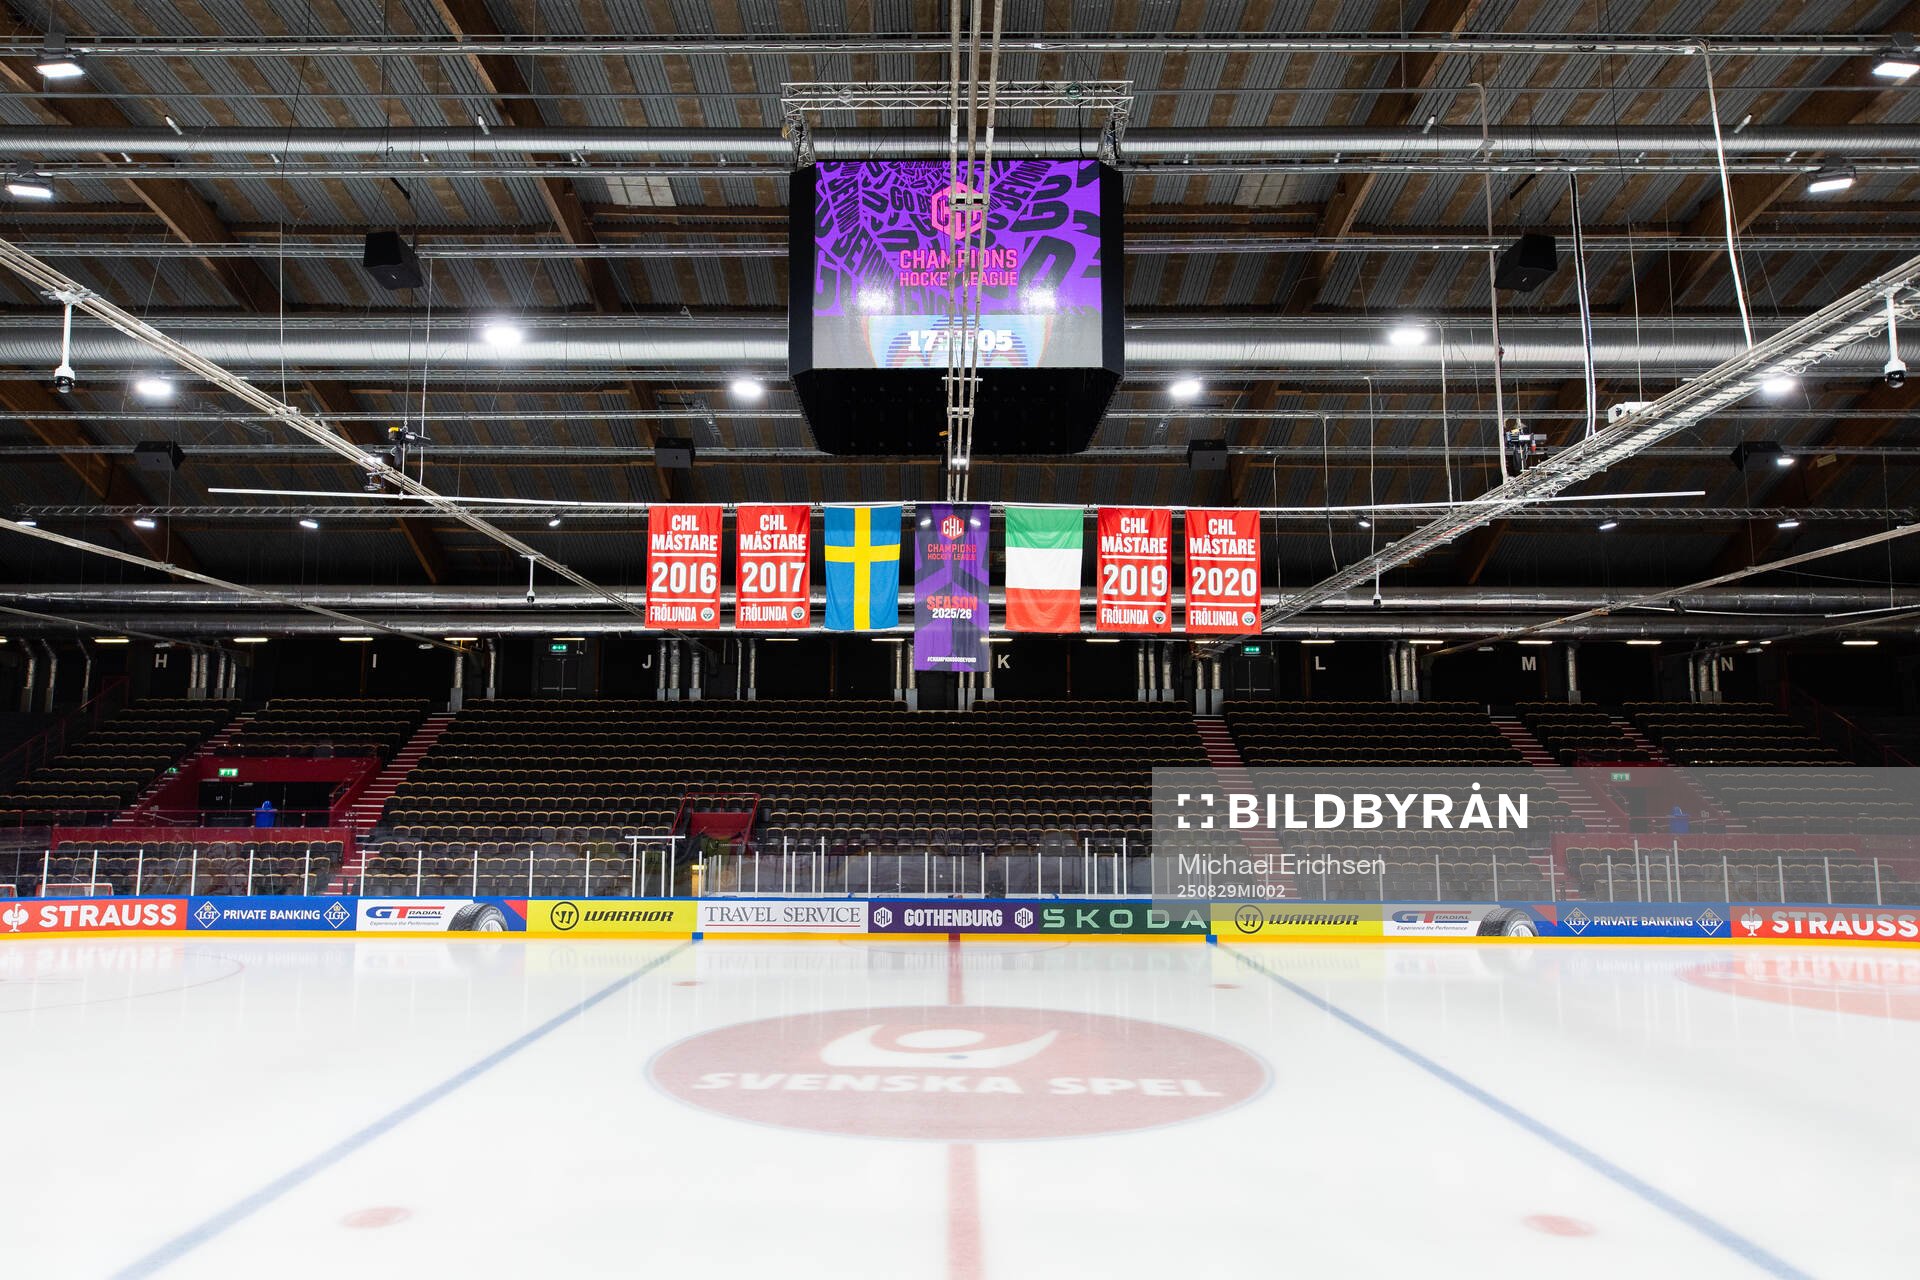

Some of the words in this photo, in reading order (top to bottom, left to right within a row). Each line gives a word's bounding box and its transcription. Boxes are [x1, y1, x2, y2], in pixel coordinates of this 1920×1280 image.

[900, 249, 1018, 269] CHAMPIONS
[671, 514, 700, 531] CHL
[759, 514, 788, 531] CHL
[943, 517, 963, 537] CHL
[1120, 517, 1149, 534] CHL
[1208, 518, 1237, 536] CHL
[651, 531, 718, 551] MÄSTARE
[740, 532, 806, 551] MÄSTARE
[927, 543, 977, 553] CHAMPIONS
[1101, 534, 1168, 554] MÄSTARE
[1189, 535, 1256, 555] MÄSTARE
[651, 561, 717, 594] 2016
[741, 562, 806, 593] 2017
[1102, 564, 1168, 597] 2019
[1191, 567, 1257, 597] 2020
[926, 595, 978, 610] SEASON
[650, 604, 697, 622] FRÖLUNDA
[740, 604, 788, 622] FRÖLUNDA
[932, 608, 972, 619] 2025/26
[1101, 606, 1149, 625] FRÖLUNDA
[1190, 608, 1238, 627] FRÖLUNDA
[154, 654, 168, 668] H
[642, 654, 652, 669] J
[997, 654, 1011, 669] K
[1315, 655, 1326, 670] L
[1521, 656, 1537, 671] M
[1720, 656, 1734, 671] N
[38, 903, 177, 928] STRAUSS
[199, 911, 217, 920] LGT
[223, 909, 267, 920] PRIVATE
[269, 909, 321, 920] BANKING
[328, 911, 346, 920] LGT
[366, 906, 410, 918] GT
[583, 910, 674, 922] WARRIOR
[705, 906, 777, 922] TRAVEL
[783, 906, 861, 923] SERVICE
[875, 908, 891, 925] CHL
[904, 908, 1003, 927] GOTHENBURG
[1016, 909, 1033, 926] CHL
[1268, 914, 1359, 925] WARRIOR
[1391, 911, 1436, 923] GT
[1569, 917, 1587, 926] LGT
[1593, 916, 1638, 926] PRIVATE
[1641, 916, 1693, 927] BANKING
[1701, 918, 1719, 927] LGT
[1772, 911, 1919, 937] STRAUSS
[691, 1071, 1024, 1094] SVENSKA
[1046, 1076, 1227, 1098] SPEL
